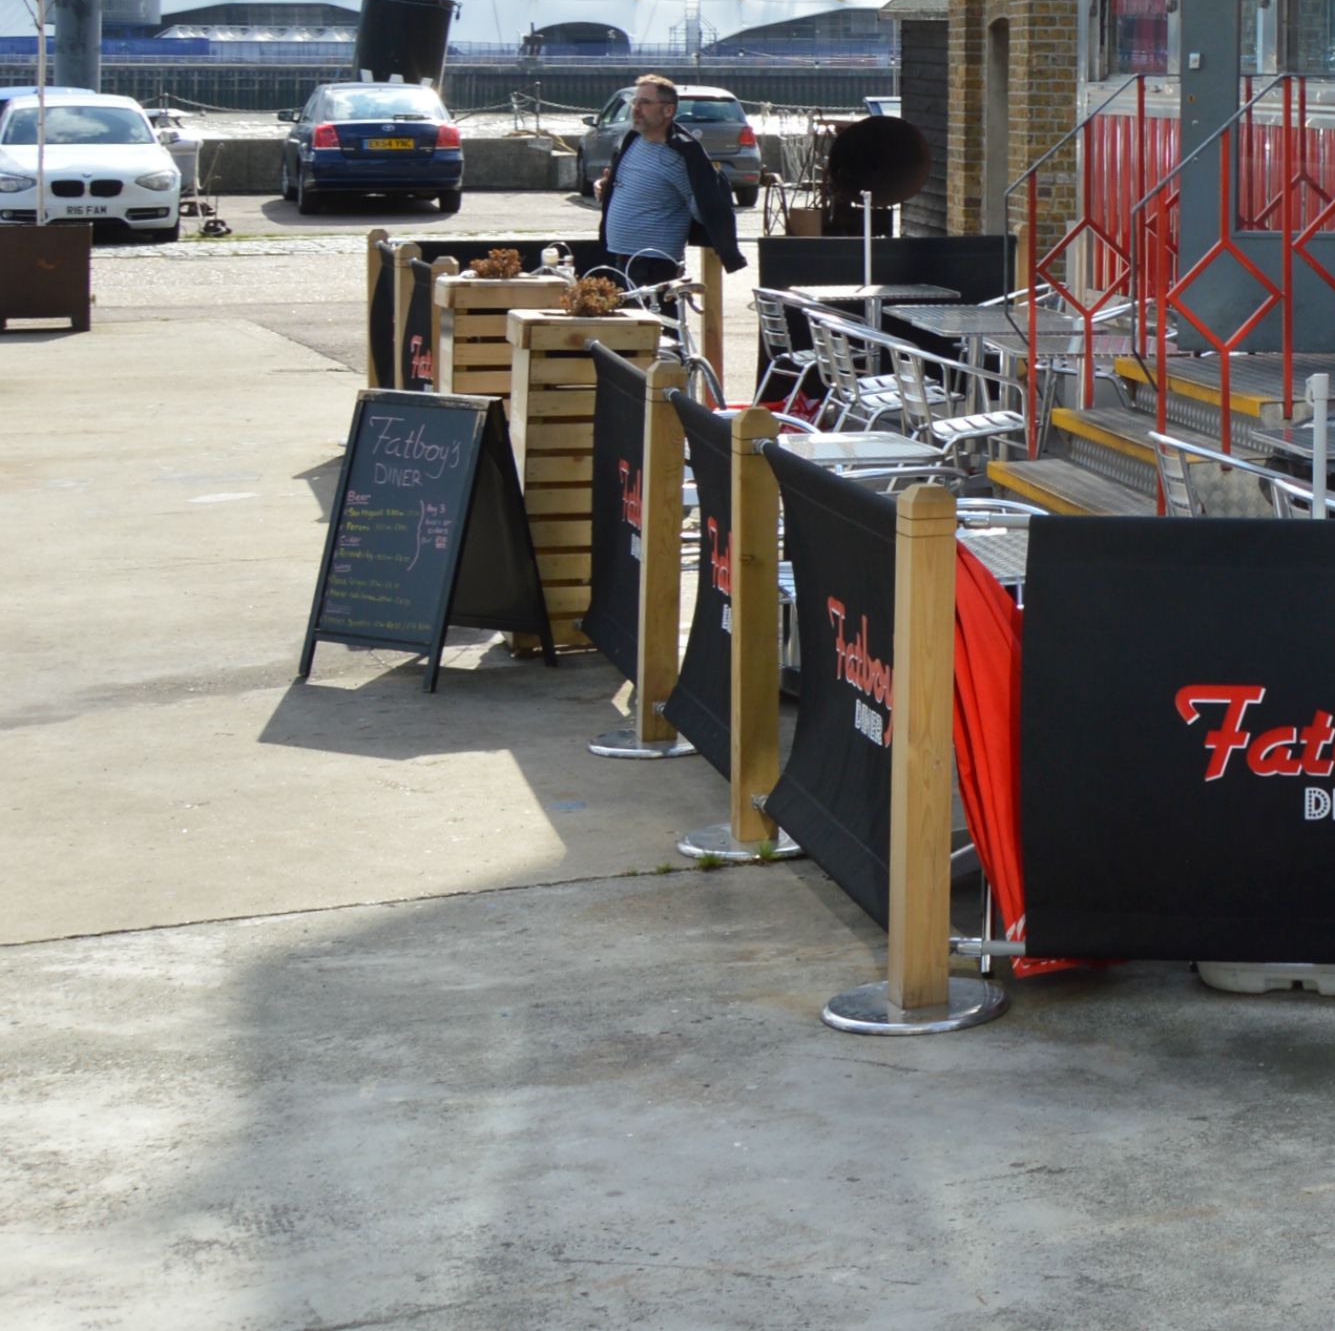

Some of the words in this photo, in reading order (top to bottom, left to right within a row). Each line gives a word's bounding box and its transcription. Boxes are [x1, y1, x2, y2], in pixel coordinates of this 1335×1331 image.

[86, 206, 107, 214] FAM
[369, 417, 461, 479] Fatboy's
[375, 463, 423, 486] DINER
[346, 491, 371, 503] Beer
